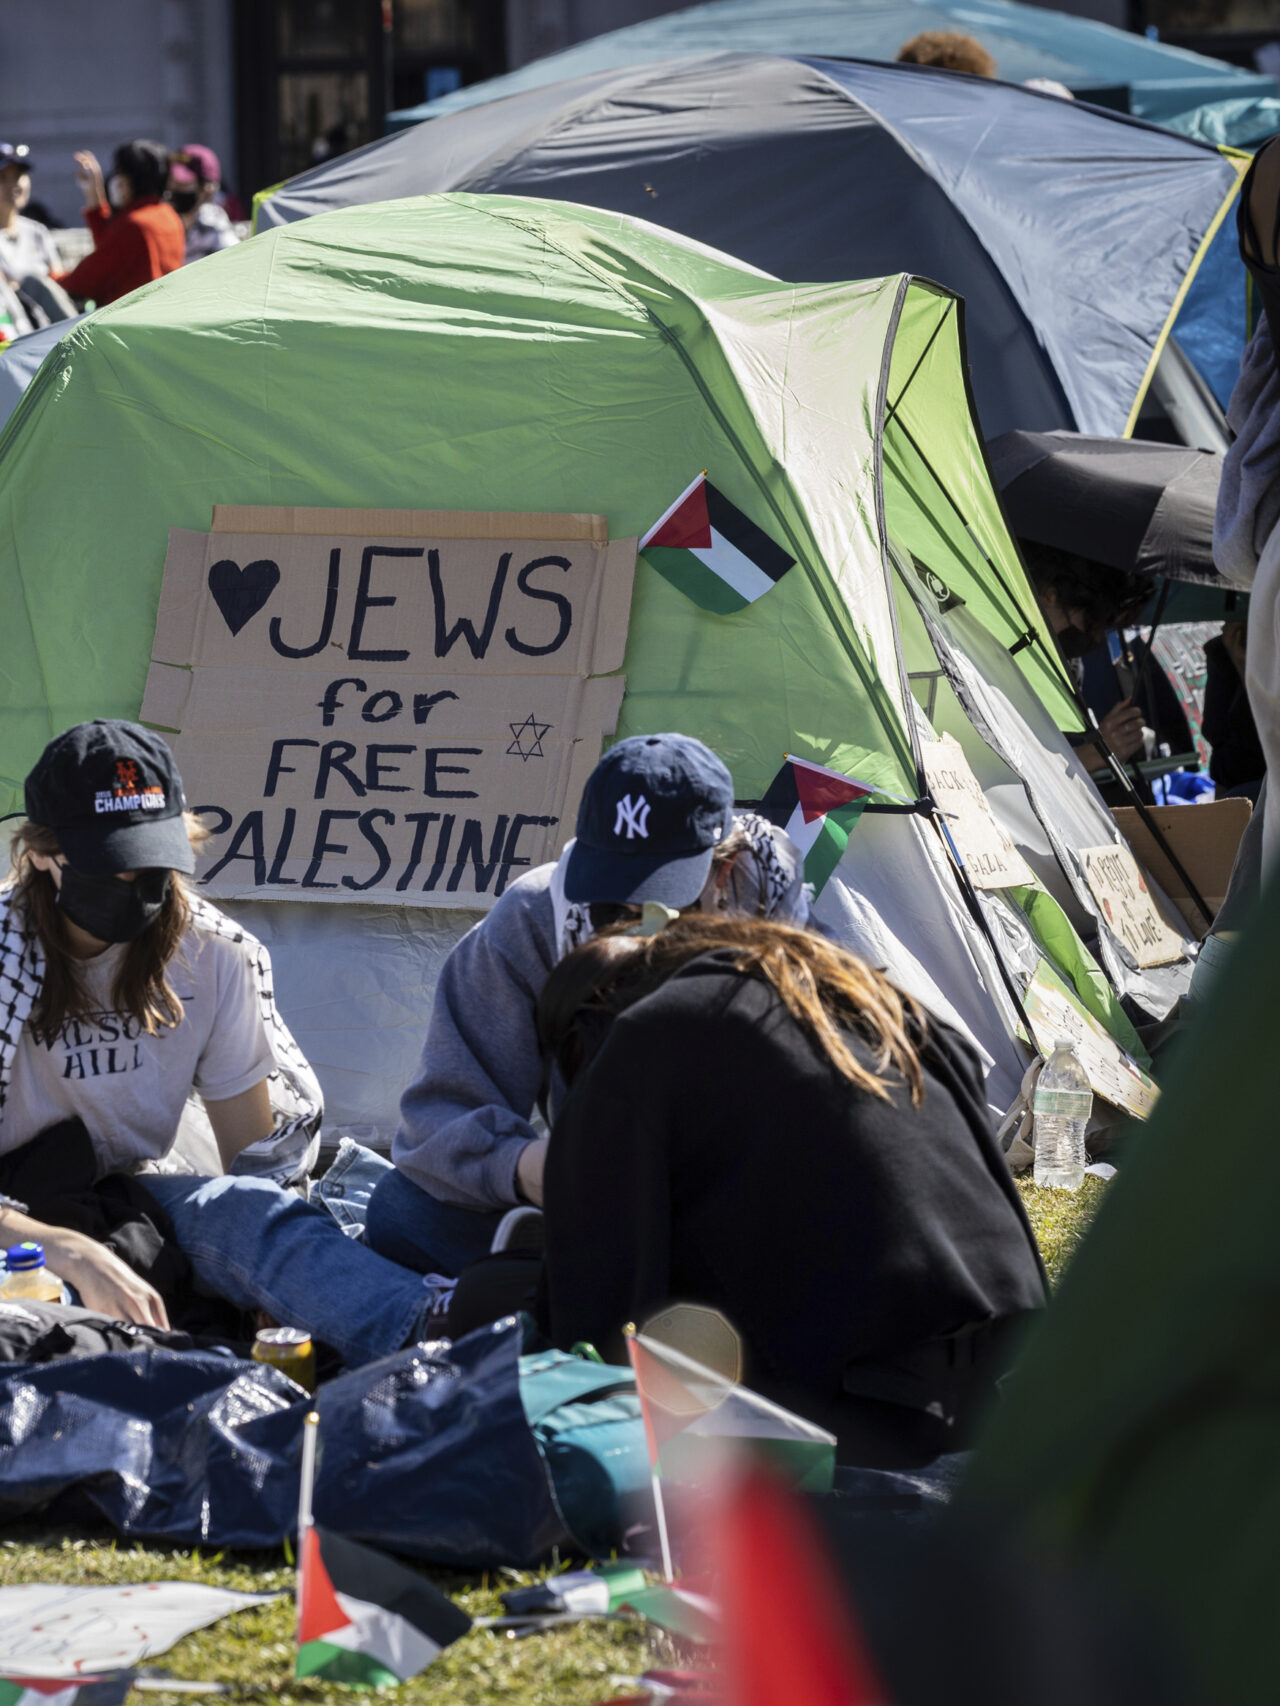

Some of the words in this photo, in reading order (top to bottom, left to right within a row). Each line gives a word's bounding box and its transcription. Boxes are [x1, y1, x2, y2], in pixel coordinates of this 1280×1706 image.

[269, 546, 573, 661] JEWS
[316, 677, 460, 727] for
[264, 739, 483, 799] FREE
[95, 793, 166, 813] CHAMPIONS
[613, 793, 651, 839] NY
[62, 1043, 143, 1079] HILL
